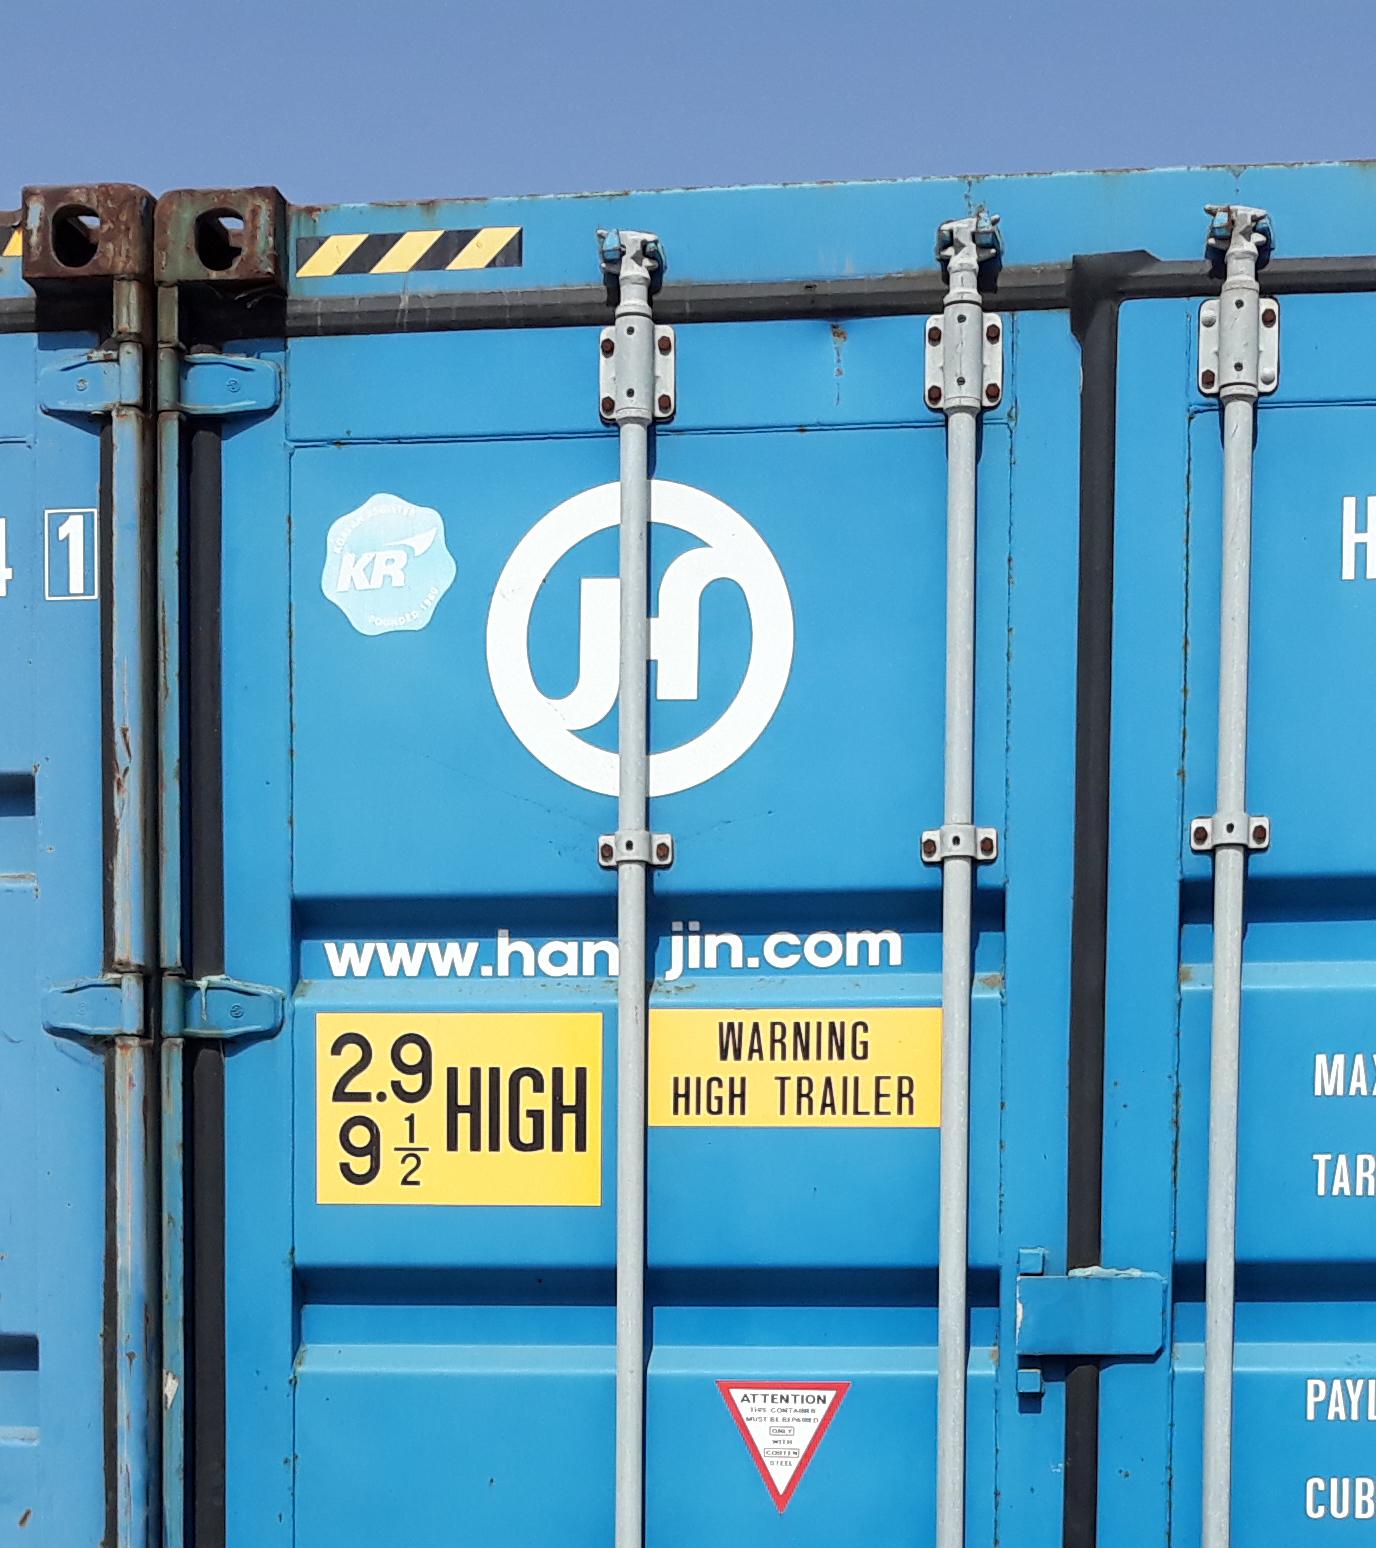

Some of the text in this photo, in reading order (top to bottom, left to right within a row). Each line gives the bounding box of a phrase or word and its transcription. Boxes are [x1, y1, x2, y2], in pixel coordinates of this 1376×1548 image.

[58, 514, 84, 594] 1
[336, 550, 409, 593] KR
[718, 1020, 869, 1061] WARNING
[330, 1032, 433, 1104] 2.9
[446, 1066, 587, 1153] HIGH
[672, 1076, 915, 1116] HIGH TRAILER
[741, 1393, 827, 1404] ATTENTION
